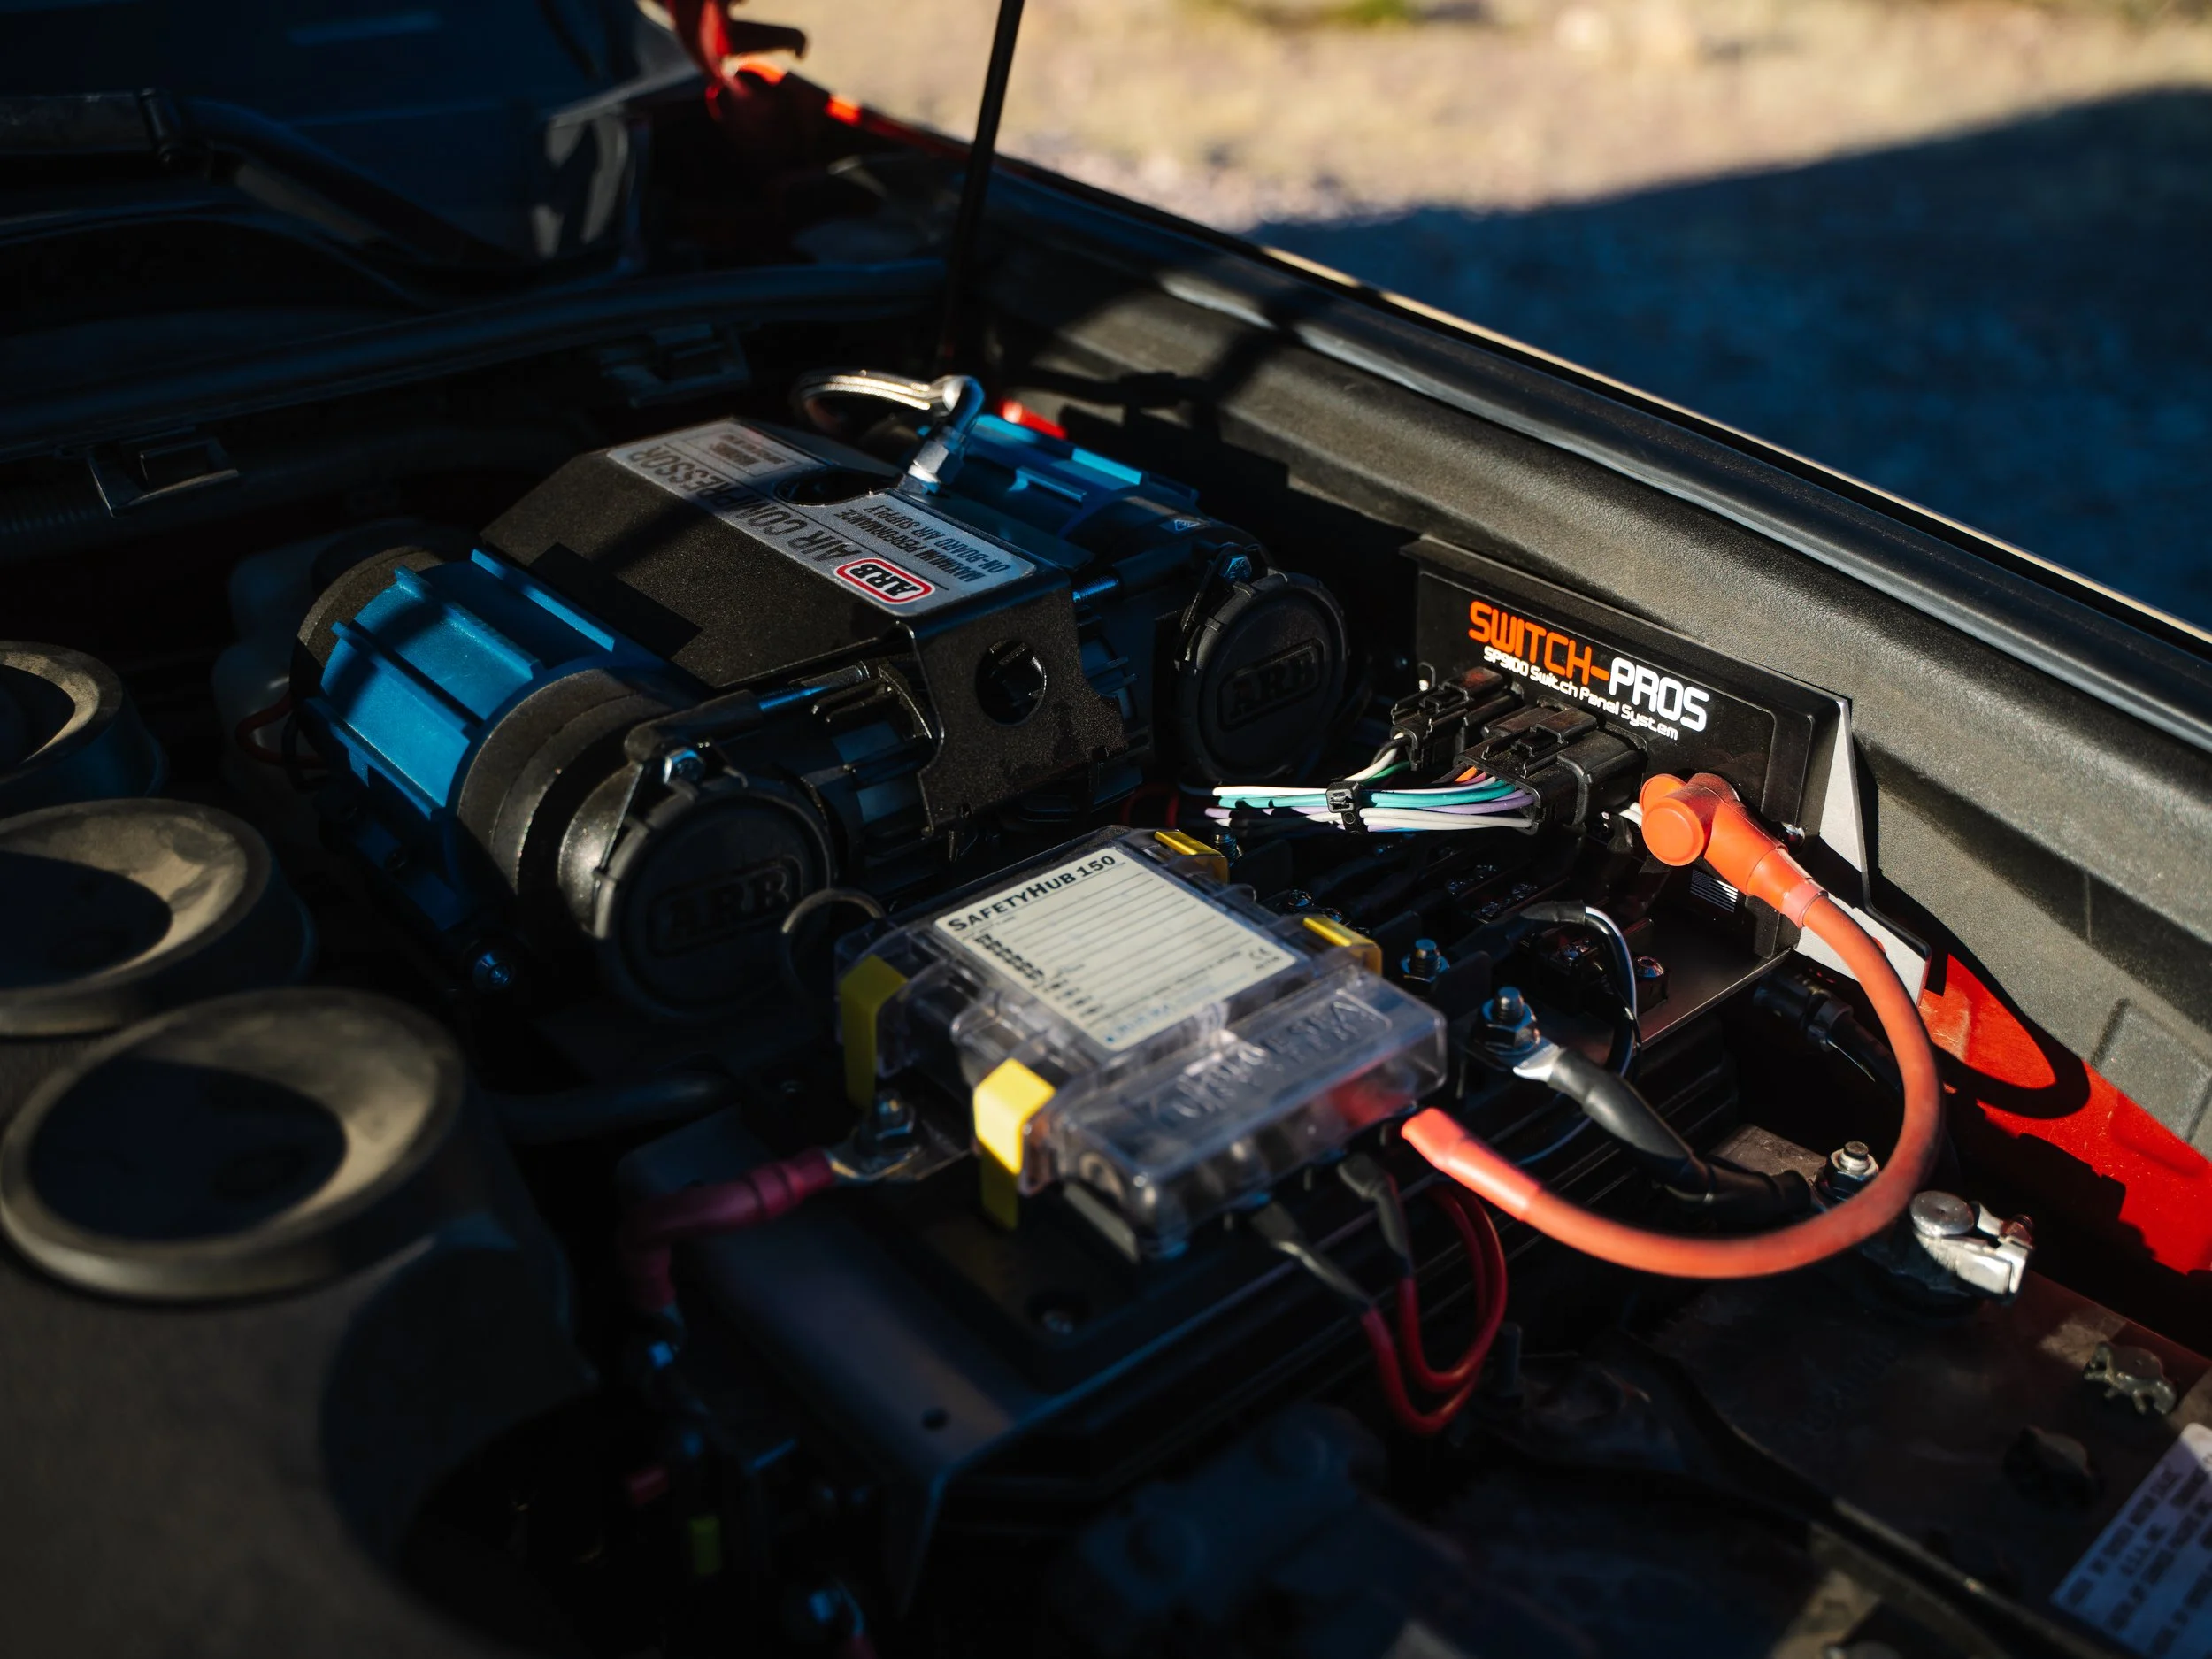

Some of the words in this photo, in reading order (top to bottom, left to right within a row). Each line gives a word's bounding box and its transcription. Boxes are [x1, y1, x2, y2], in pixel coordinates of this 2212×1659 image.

[629, 446, 808, 535] COMPRESSOR
[833, 509, 928, 553] PERFORMANCE
[862, 504, 920, 530] SUPPLY
[910, 526, 946, 541] AIR
[787, 530, 863, 562] AIR
[933, 538, 1010, 573] ON-BOARD
[849, 564, 919, 597] ARB
[913, 549, 987, 582] MAXIMUM
[1468, 600, 1709, 732] SWITCH-PROS
[1530, 666, 1578, 698] Switch
[1579, 686, 1620, 716] Panel
[1622, 704, 1678, 741] System
[1077, 856, 1116, 878] 150
